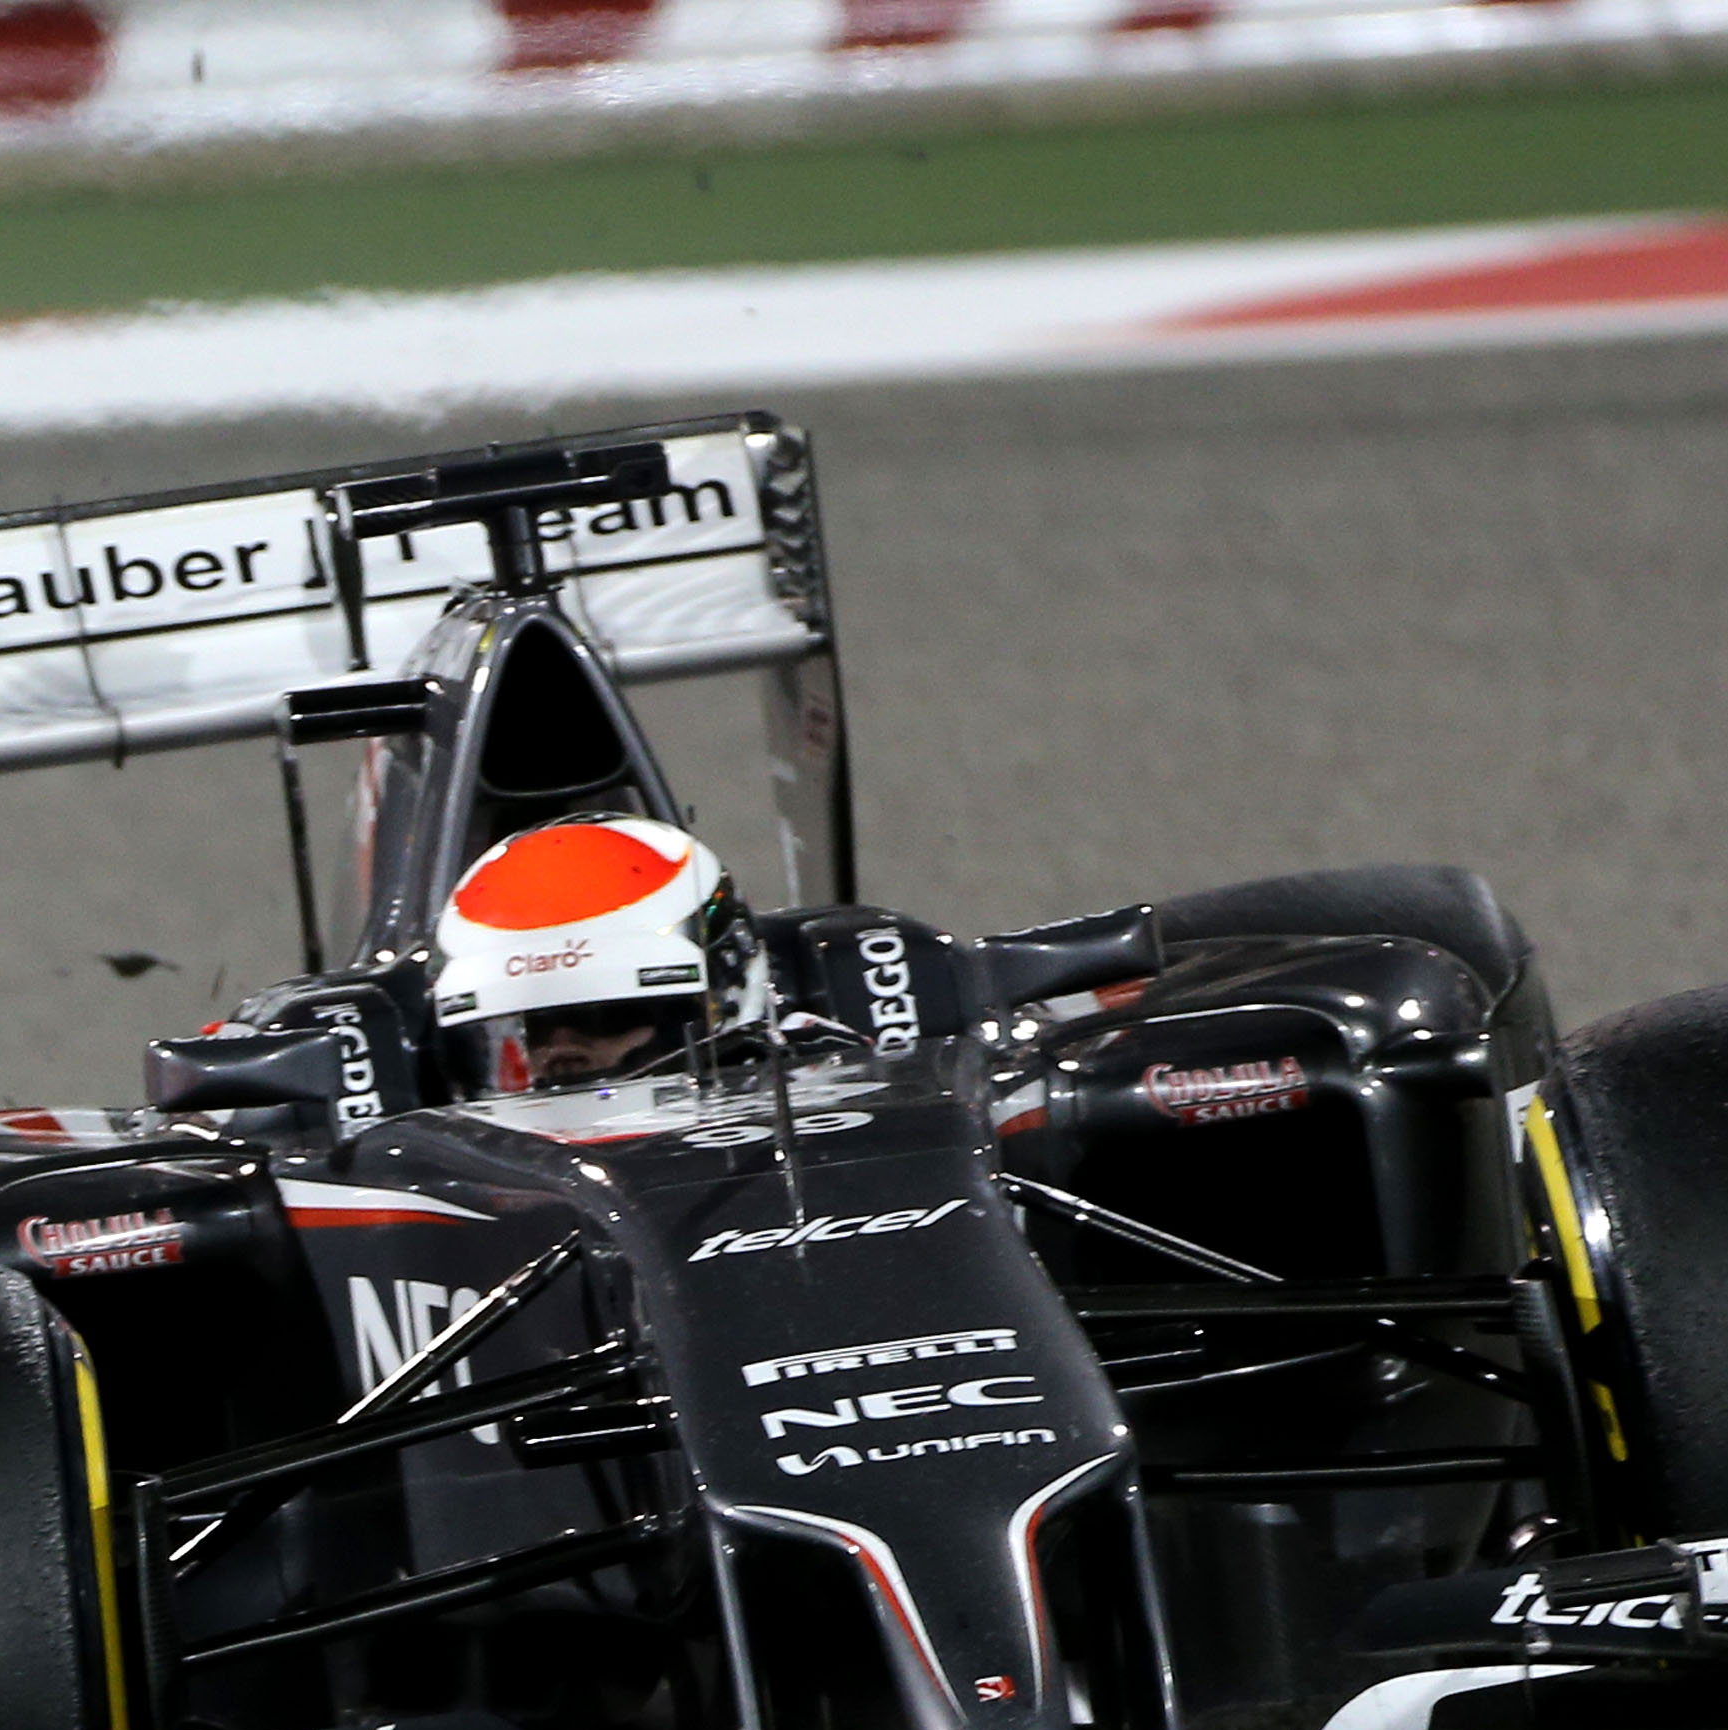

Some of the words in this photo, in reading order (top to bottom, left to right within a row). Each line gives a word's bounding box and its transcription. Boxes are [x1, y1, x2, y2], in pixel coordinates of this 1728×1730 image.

[681, 1112, 875, 1149] 99
[1195, 1094, 1293, 1124] SAUCE
[687, 1198, 971, 1263] telcel
[69, 1246, 167, 1275] SAUCE
[741, 1328, 1018, 1387] PIRELLI
[760, 1375, 1045, 1440] NEC
